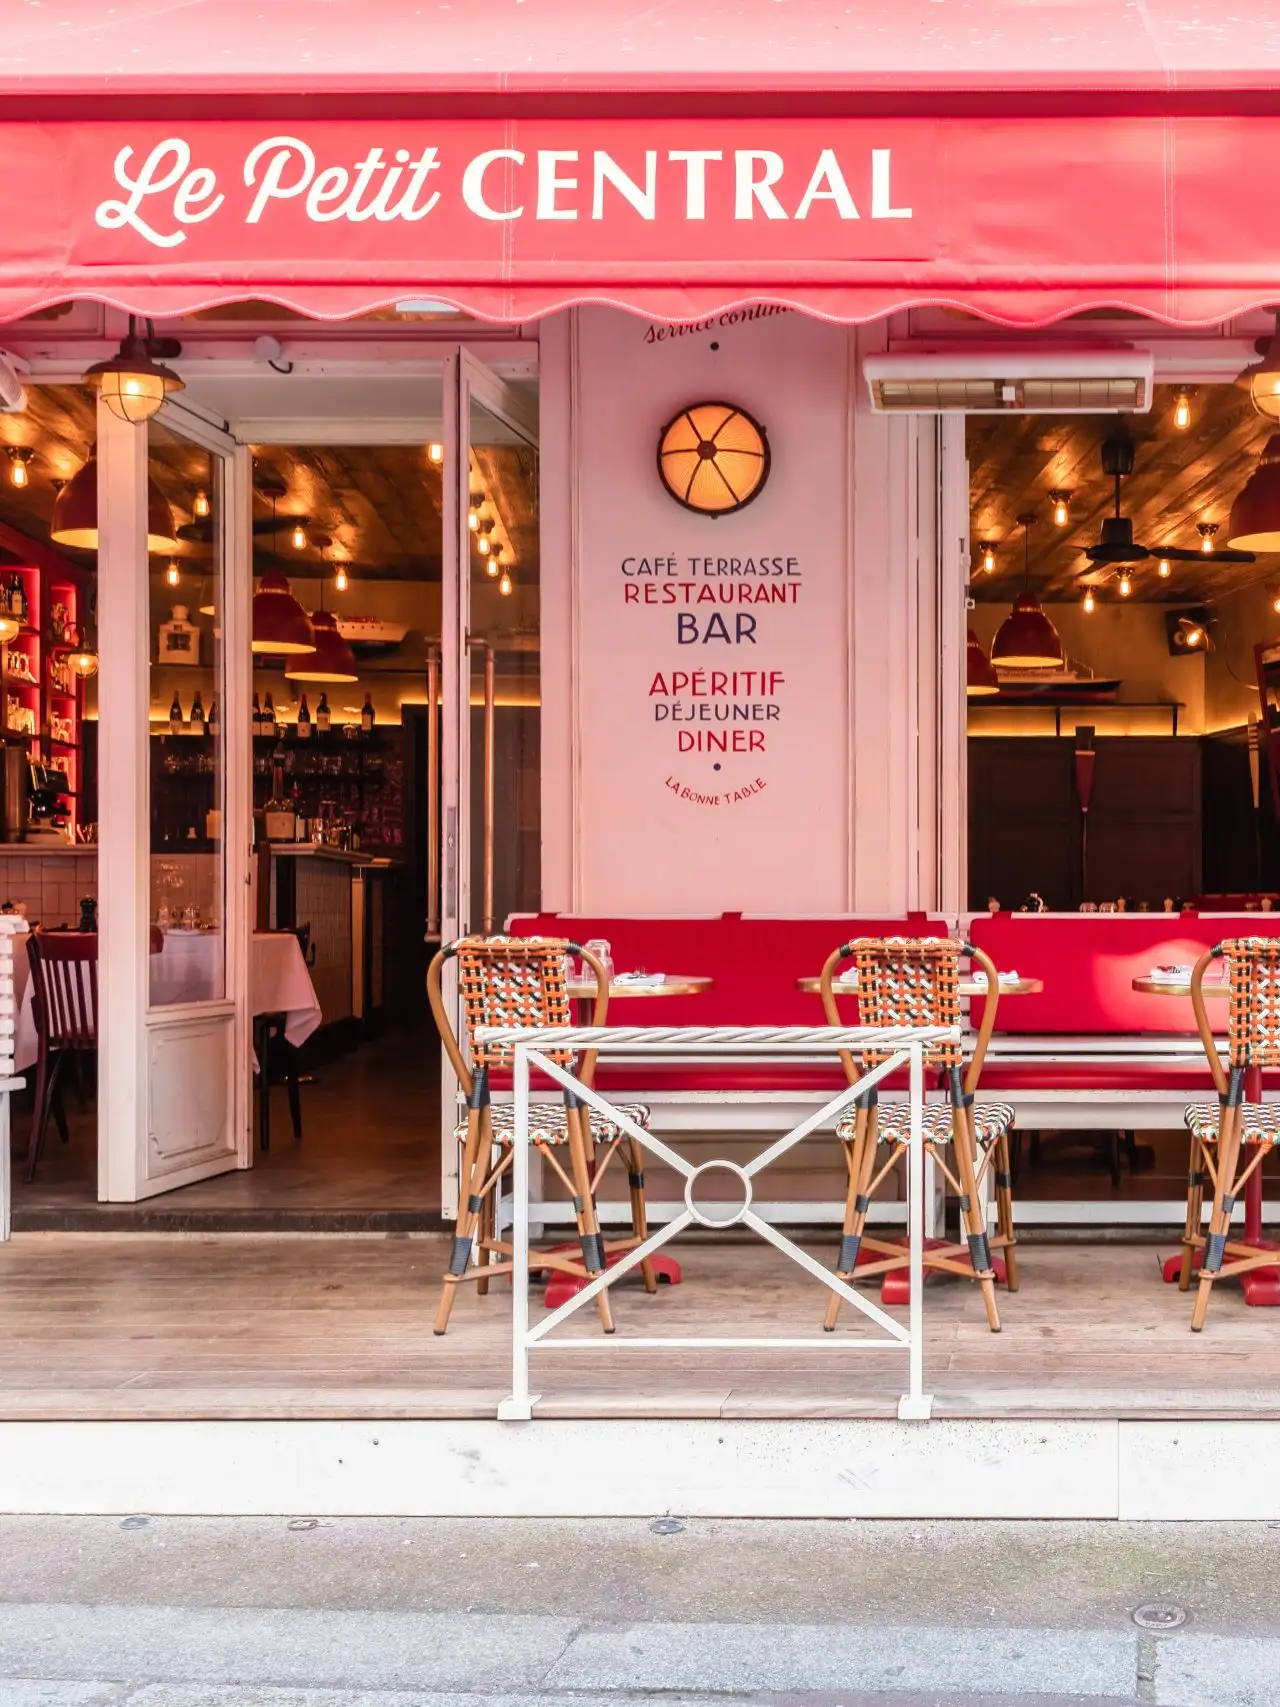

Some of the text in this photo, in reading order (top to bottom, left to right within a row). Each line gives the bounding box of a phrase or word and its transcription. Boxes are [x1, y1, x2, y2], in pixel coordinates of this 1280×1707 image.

[95, 136, 912, 247] Le Petit CENTRAL
[621, 551, 802, 577] CAFÉ TERRASSE
[624, 582, 803, 605] RESTAURANT
[677, 612, 757, 645] BAR
[649, 667, 785, 696] APÉRITIF
[655, 700, 781, 722] DÉJEUNER
[678, 730, 766, 752] DINER
[665, 776, 767, 805] LA BONNE TABLE
